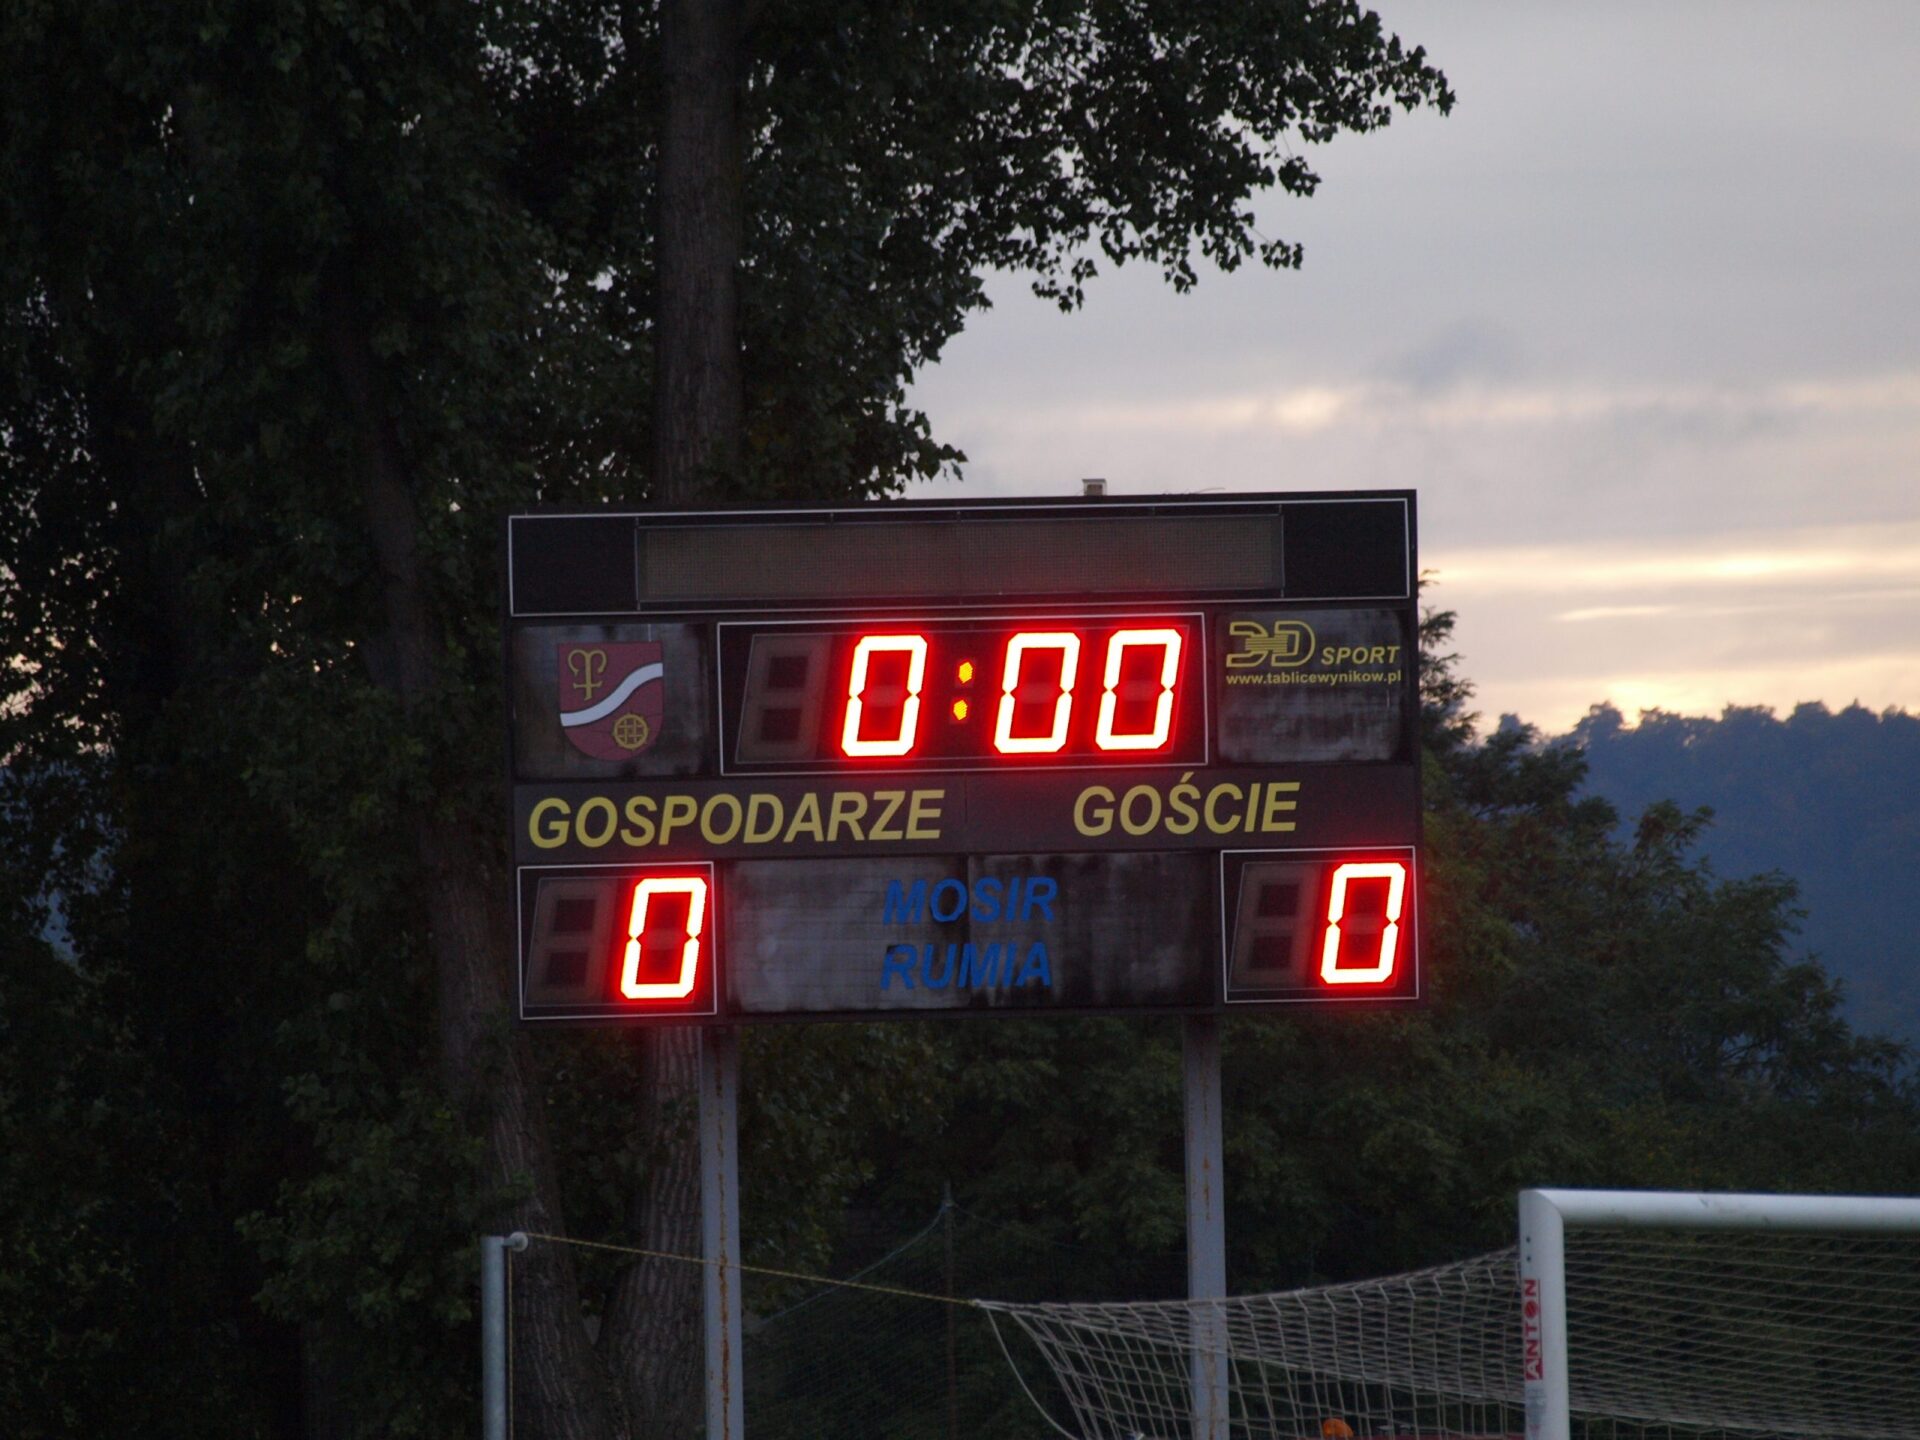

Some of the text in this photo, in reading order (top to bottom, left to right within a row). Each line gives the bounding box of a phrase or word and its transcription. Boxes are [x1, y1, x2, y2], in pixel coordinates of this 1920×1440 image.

[1226, 670, 1401, 687] www.tablicewynikow.pl
[1321, 645, 1400, 665] SPORT
[528, 790, 944, 848] GOSPODARZE
[1073, 772, 1301, 836] GOŚCIE
[883, 876, 1058, 925] MOSIR
[1321, 862, 1406, 984] 0
[621, 876, 707, 999] 0
[881, 941, 1053, 989] RUMIA
[1524, 1279, 1543, 1380] ANTON
